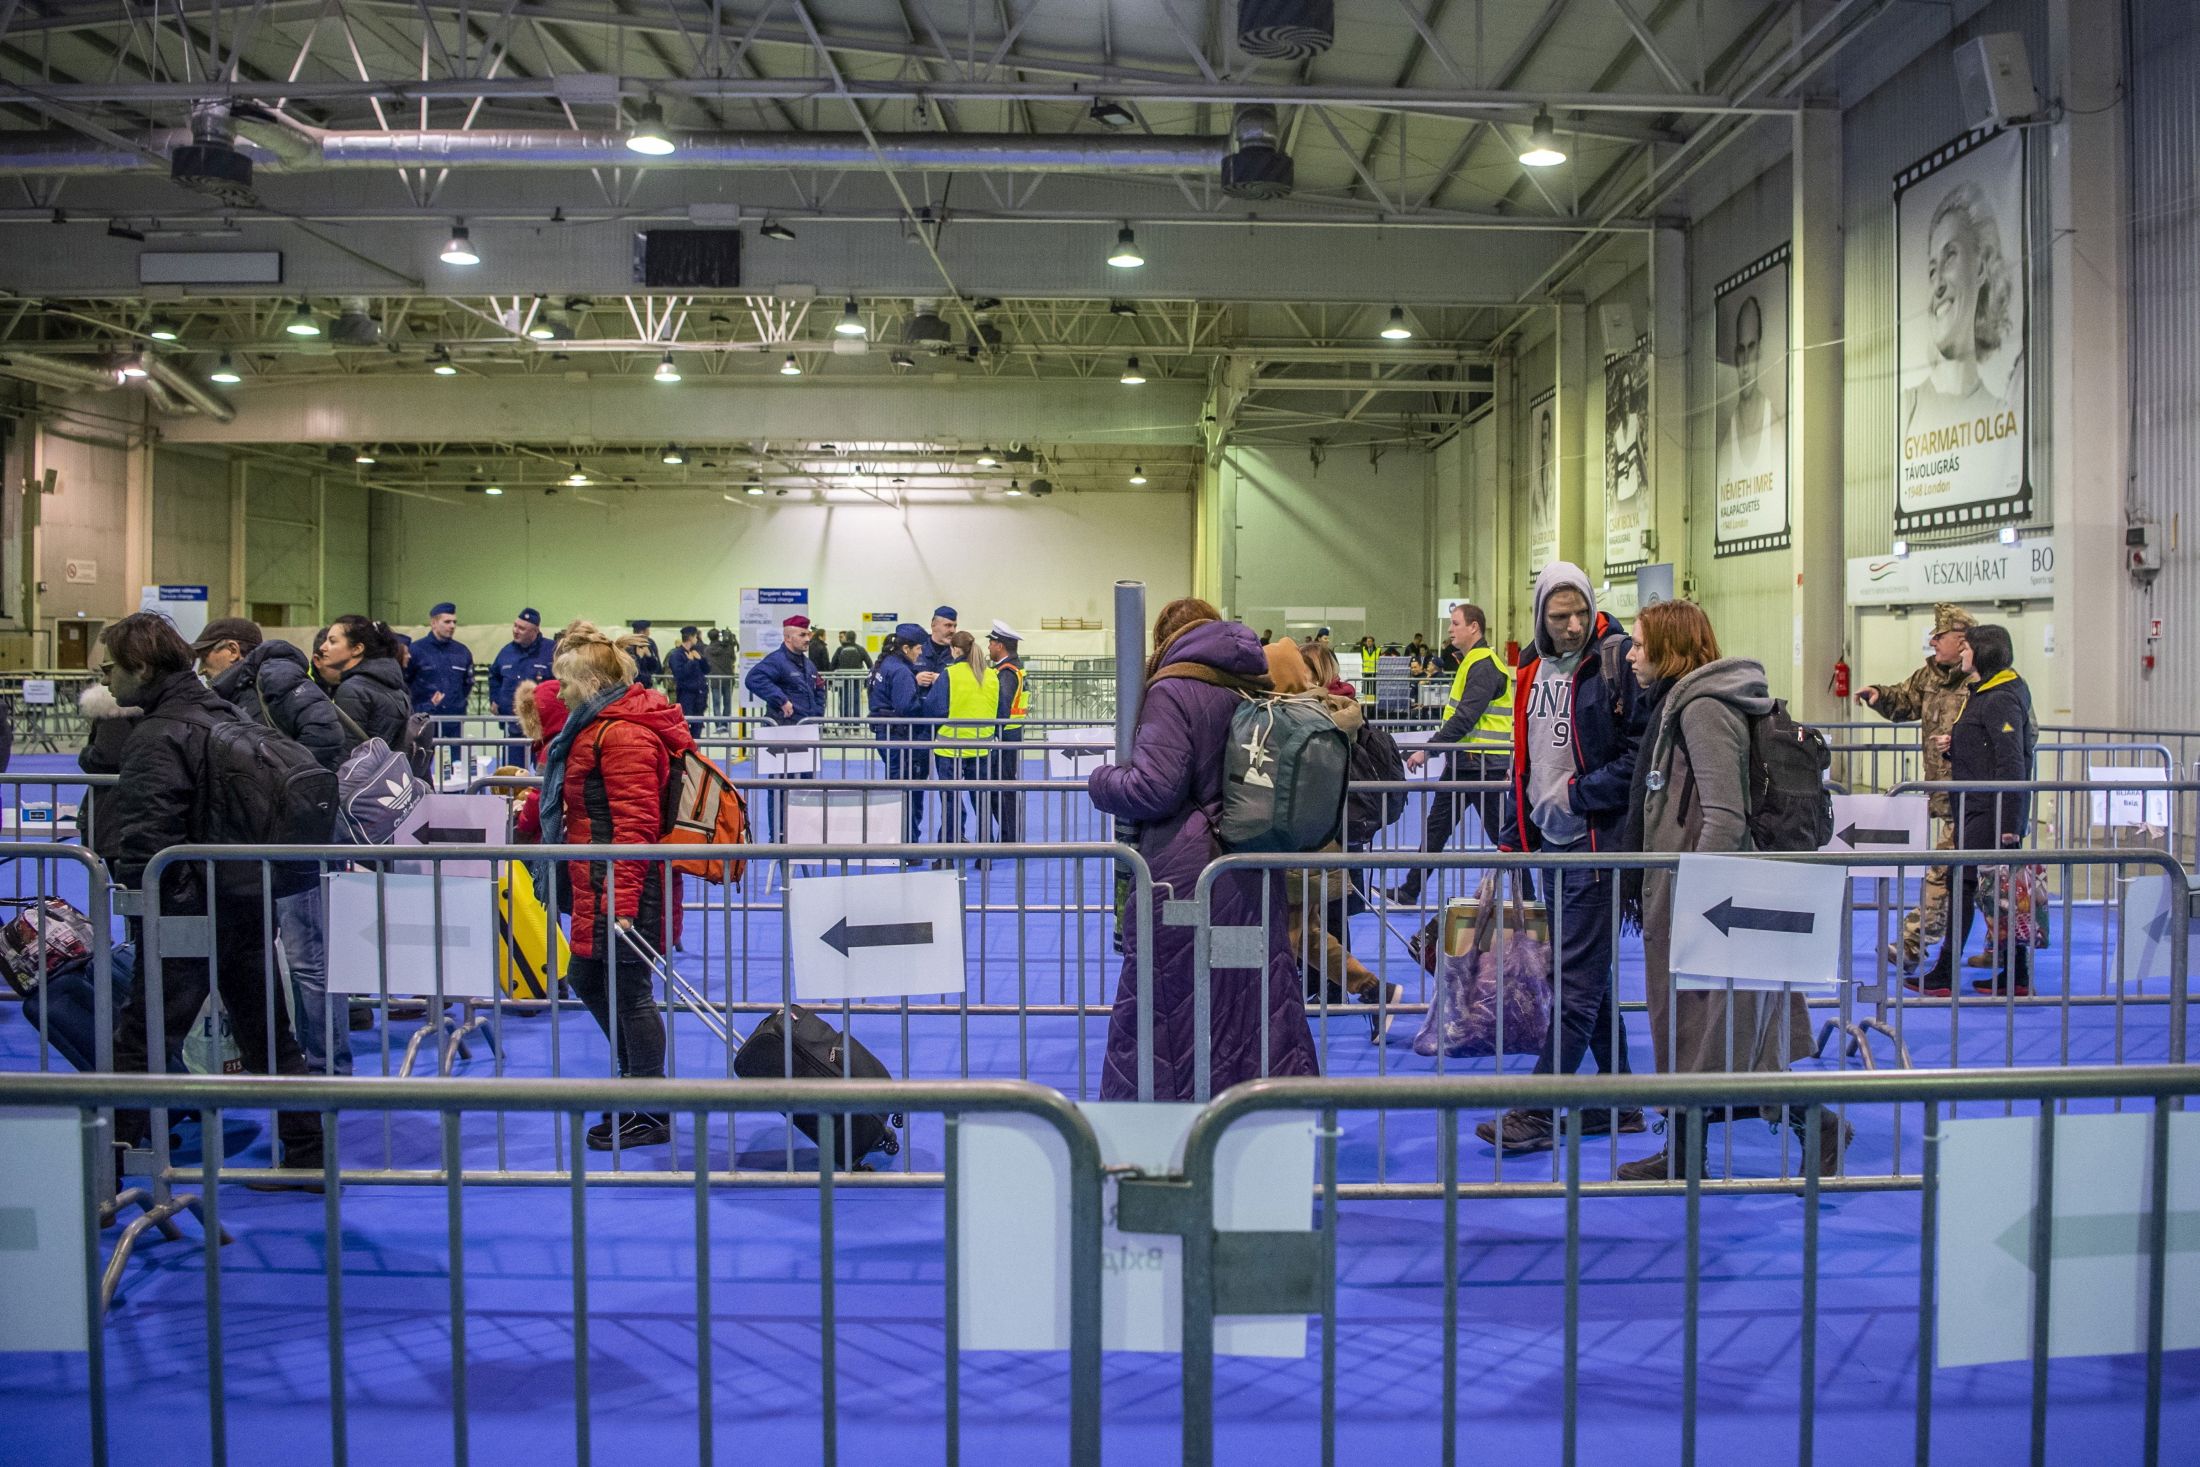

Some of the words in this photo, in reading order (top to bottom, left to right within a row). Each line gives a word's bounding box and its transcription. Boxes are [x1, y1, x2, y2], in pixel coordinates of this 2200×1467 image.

[1904, 422, 1971, 460] GYARMATI
[1975, 410, 2018, 444] OLGA
[1904, 453, 1960, 480] TÁVOLUGRÁS
[1924, 480, 1951, 496] London
[1924, 555, 2009, 587] VÉSZKIJÁRAT
[2032, 546, 2054, 572] BO
[1551, 720, 1570, 749] 9
